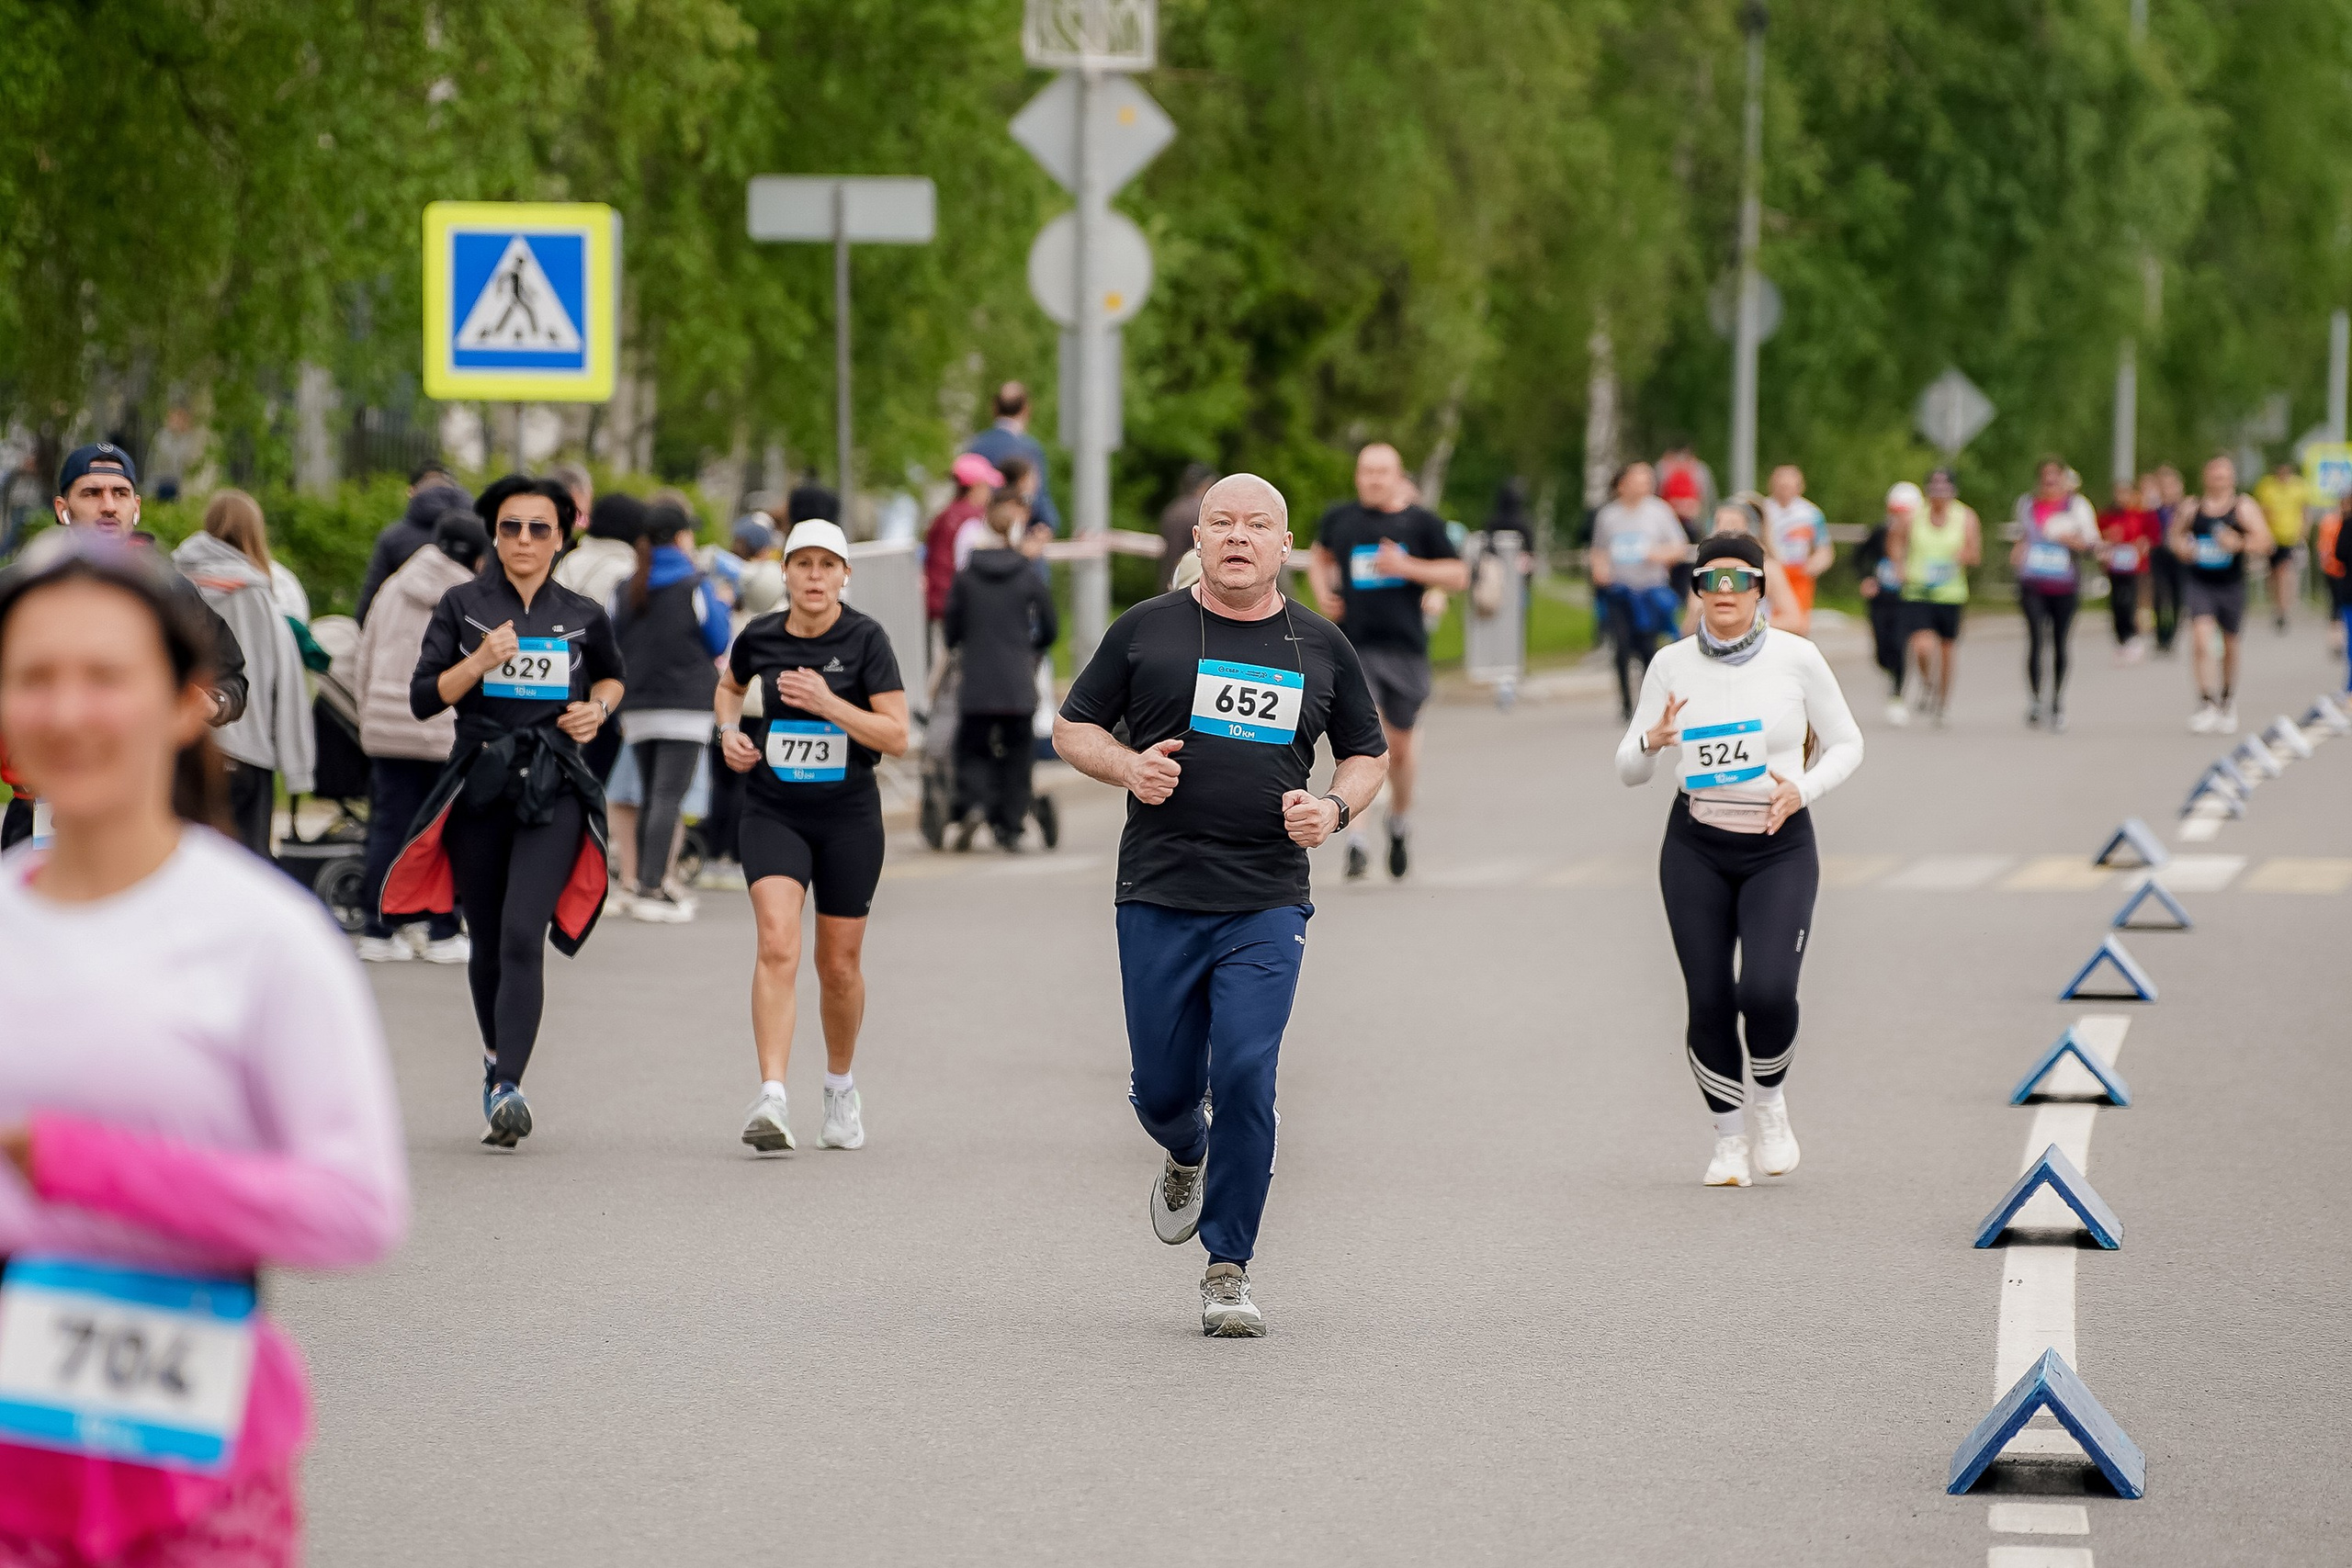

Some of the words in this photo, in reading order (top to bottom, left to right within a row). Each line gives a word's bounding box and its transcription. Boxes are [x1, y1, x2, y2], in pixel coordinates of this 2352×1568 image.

[502, 657, 552, 680] 629
[1215, 683, 1280, 721] 652
[781, 738, 831, 763] 773
[1698, 739, 1749, 767] 524
[53, 1315, 193, 1399] 704
